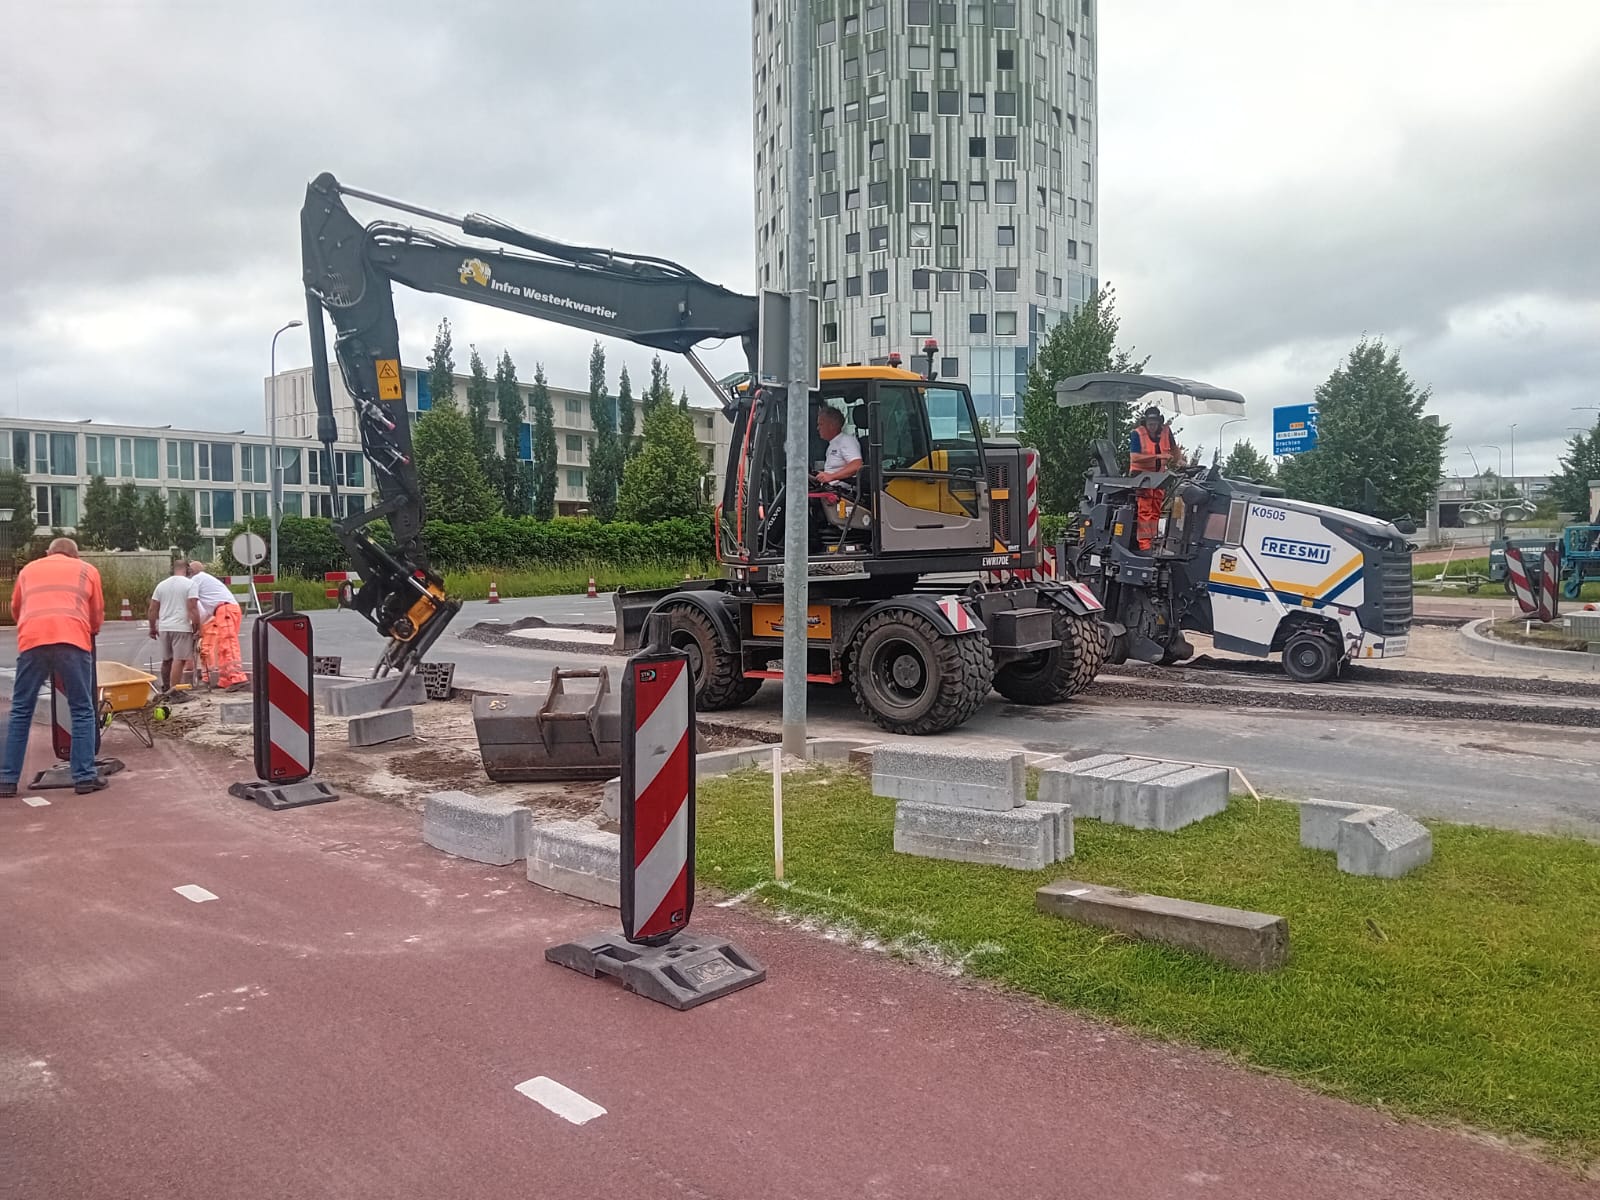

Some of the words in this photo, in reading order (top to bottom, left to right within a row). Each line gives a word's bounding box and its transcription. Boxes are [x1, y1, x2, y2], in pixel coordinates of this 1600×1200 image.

[491, 279, 520, 296] Infra
[523, 286, 617, 319] Westerkwartier
[1252, 506, 1286, 521] K0505
